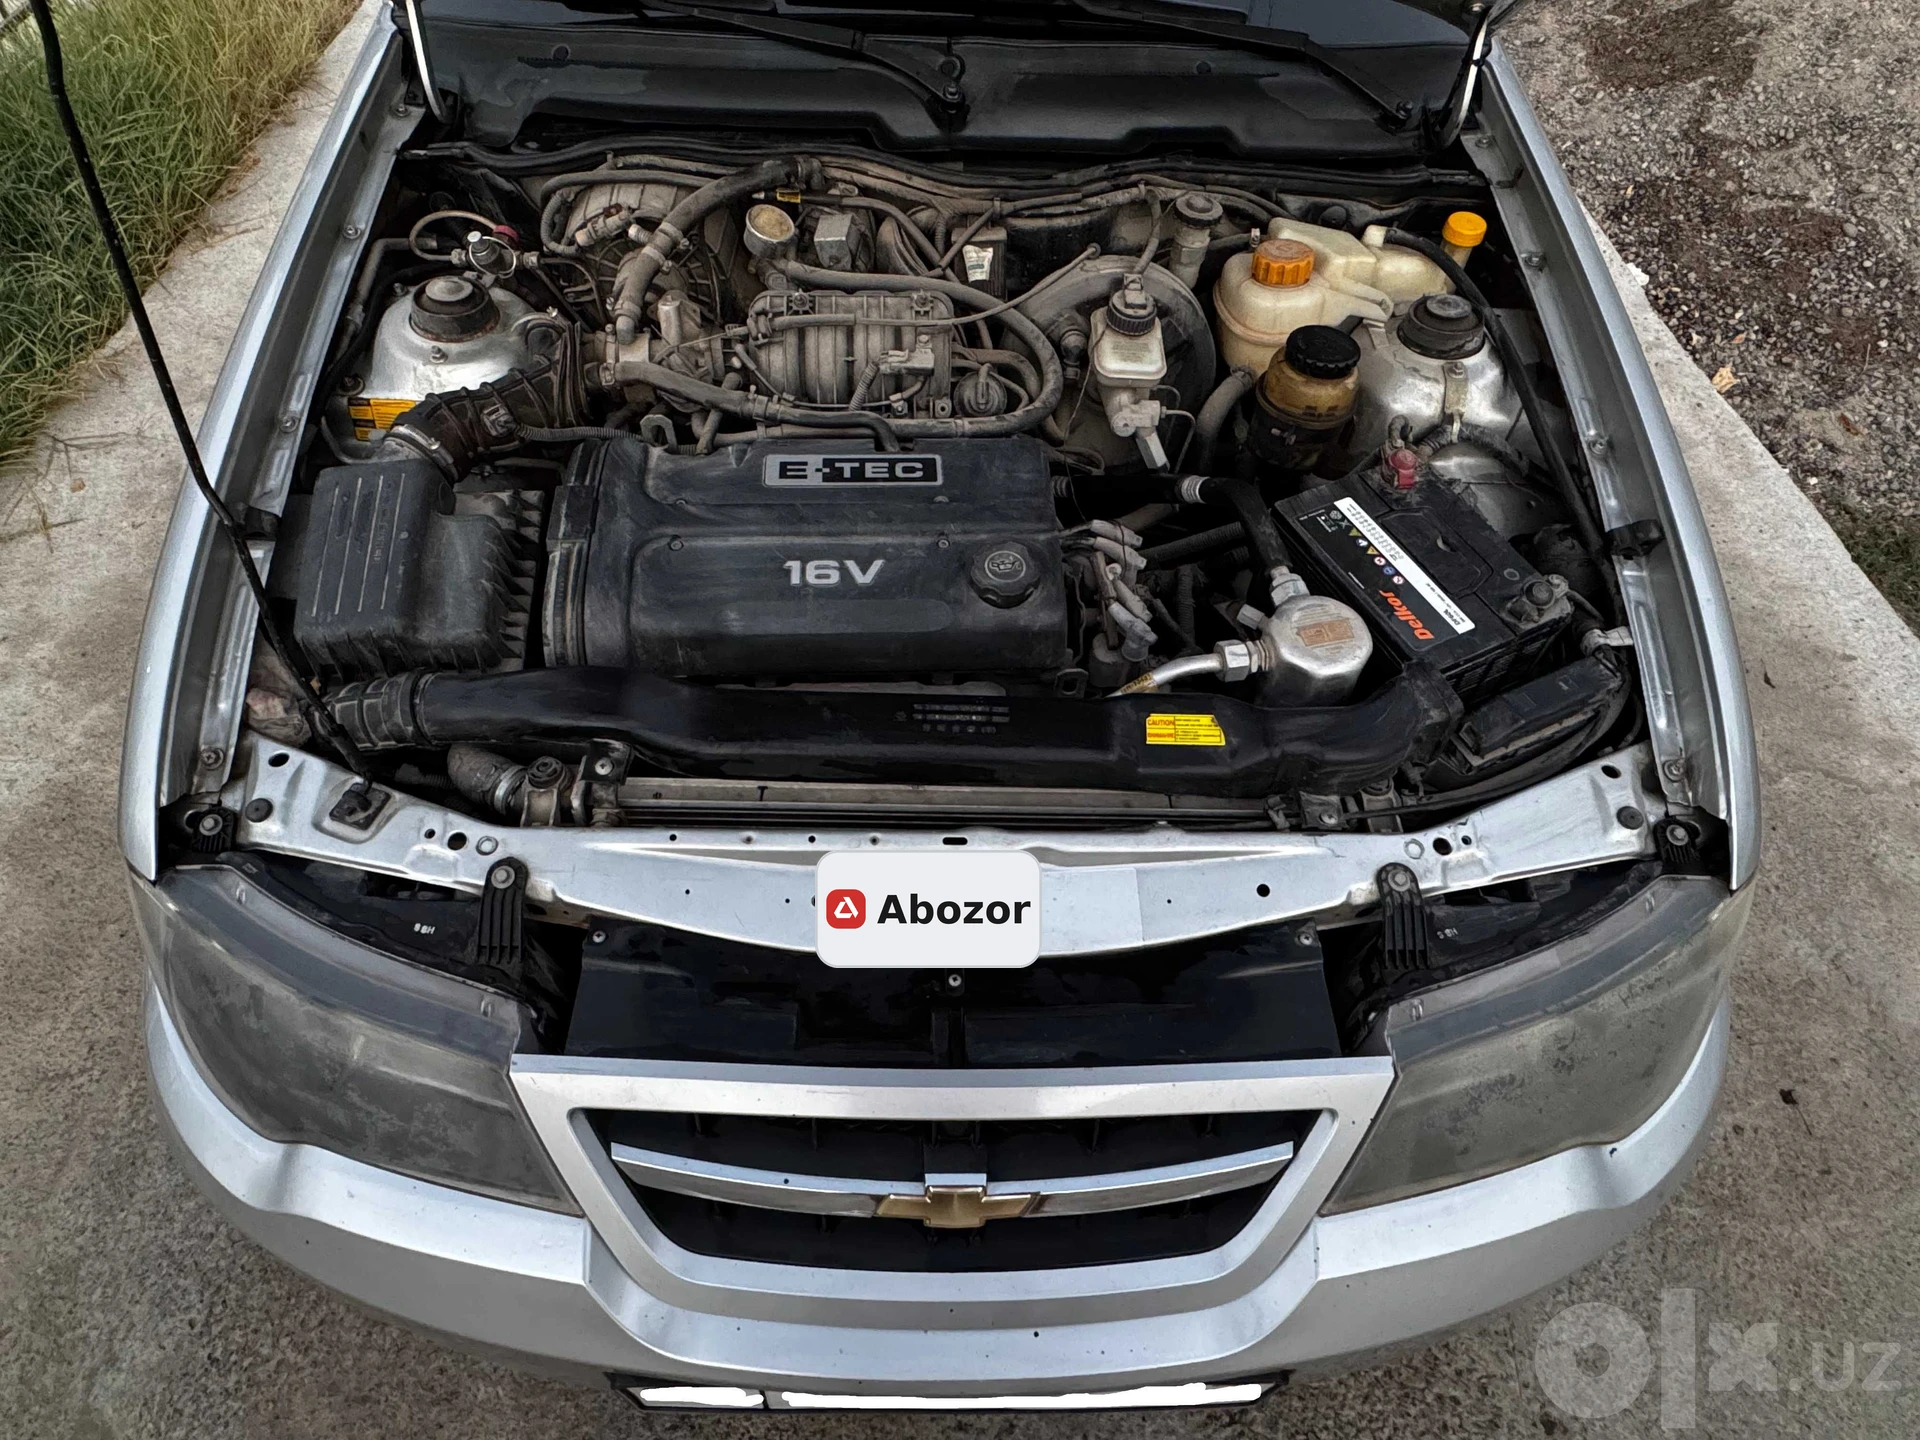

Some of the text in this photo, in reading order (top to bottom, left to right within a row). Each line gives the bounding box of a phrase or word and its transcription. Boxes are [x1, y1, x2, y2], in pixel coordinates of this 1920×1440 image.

[778, 461, 924, 479] E-TEC
[783, 559, 886, 586] 16V
[1379, 590, 1435, 640] Delkor
[1147, 719, 1175, 727] CAUTION
